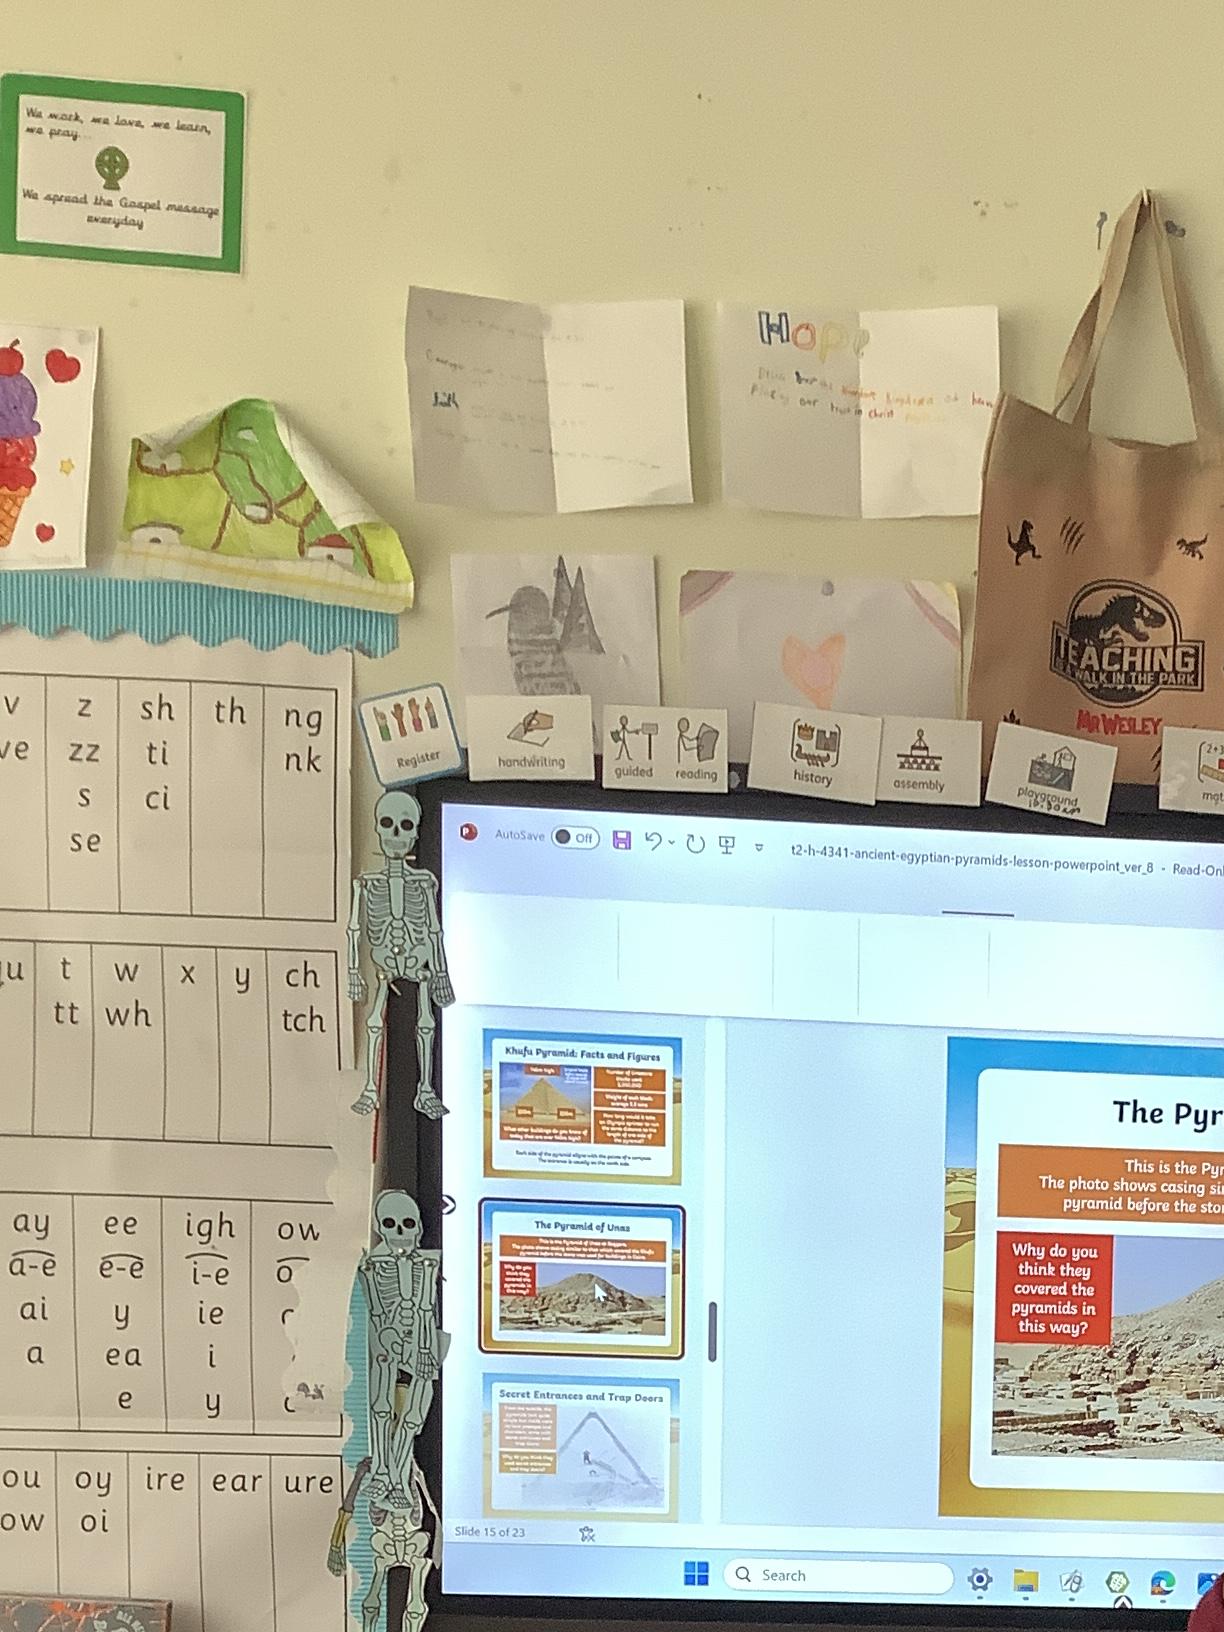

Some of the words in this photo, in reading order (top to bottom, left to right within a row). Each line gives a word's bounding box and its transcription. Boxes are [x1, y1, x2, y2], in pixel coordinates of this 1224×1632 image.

[26, 107, 43, 120] We
[91, 117, 109, 125] we
[152, 122, 171, 130] we
[26, 126, 44, 134] we
[22, 188, 39, 200] We
[44, 193, 88, 206] spread
[94, 195, 113, 206] the
[119, 198, 161, 211] Gospel
[166, 204, 219, 217] message
[87, 215, 144, 229] everyday
[1057, 631, 1197, 672] TEACHING
[1112, 672, 1126, 684] IN
[1131, 672, 1154, 684] THE
[1160, 672, 1196, 686] PARK
[141, 693, 174, 720] sh
[215, 696, 246, 724] th
[285, 707, 321, 736] ng
[1100, 713, 1163, 735] WESLEY
[147, 741, 168, 765] ti
[285, 746, 321, 772] nk
[397, 750, 440, 768] Register
[498, 756, 566, 770] handwriting
[614, 766, 653, 779] guided
[675, 768, 718, 782] reading
[793, 770, 832, 788] history
[893, 778, 945, 793] assembly
[1018, 785, 1078, 806] playground
[495, 829, 545, 842] AutoSave
[575, 832, 592, 844] Off
[285, 961, 320, 987] ch
[105, 1000, 151, 1026] wh
[282, 1006, 325, 1032] tch
[505, 1047, 533, 1056] Khufu
[536, 1049, 577, 1058] Pyramid:
[581, 1051, 604, 1059] Facts
[607, 1052, 624, 1060] and
[627, 1053, 660, 1062] Figures
[1113, 1100, 1163, 1124] The
[1124, 1160, 1155, 1174] This
[1039, 1176, 1065, 1190] The
[1069, 1176, 1109, 1192] photo
[1113, 1178, 1156, 1192] shows
[1160, 1182, 1205, 1196] casing
[1063, 1197, 1123, 1213] pyramid
[1127, 1199, 1170, 1216] before
[13, 1214, 49, 1240] ay
[104, 1215, 137, 1235] ee
[186, 1211, 235, 1244] igh
[1012, 1243, 1045, 1259] Why
[1050, 1244, 1067, 1258] do
[1072, 1246, 1098, 1260] you
[1018, 1263, 1056, 1276] think
[1060, 1264, 1091, 1280] they
[1014, 1282, 1067, 1296] covered
[1072, 1283, 1094, 1297] the
[1012, 1301, 1078, 1316] pyramids
[1082, 1302, 1096, 1315] in
[1018, 1320, 1045, 1334] this
[1049, 1321, 1088, 1337] way?
[500, 1390, 530, 1399] Secret
[534, 1391, 583, 1400] Entrances
[586, 1392, 604, 1401] and
[608, 1393, 631, 1403] Trap
[635, 1394, 663, 1402] Doors
[3, 1469, 40, 1488] ou
[75, 1470, 111, 1496] oy
[147, 1467, 184, 1491] ire
[212, 1474, 262, 1492] ear
[285, 1475, 333, 1493] ure
[455, 1527, 480, 1537] Slide
[484, 1528, 496, 1537] 15
[499, 1527, 510, 1537] of
[512, 1528, 525, 1537] 23
[762, 1567, 806, 1583] Search
